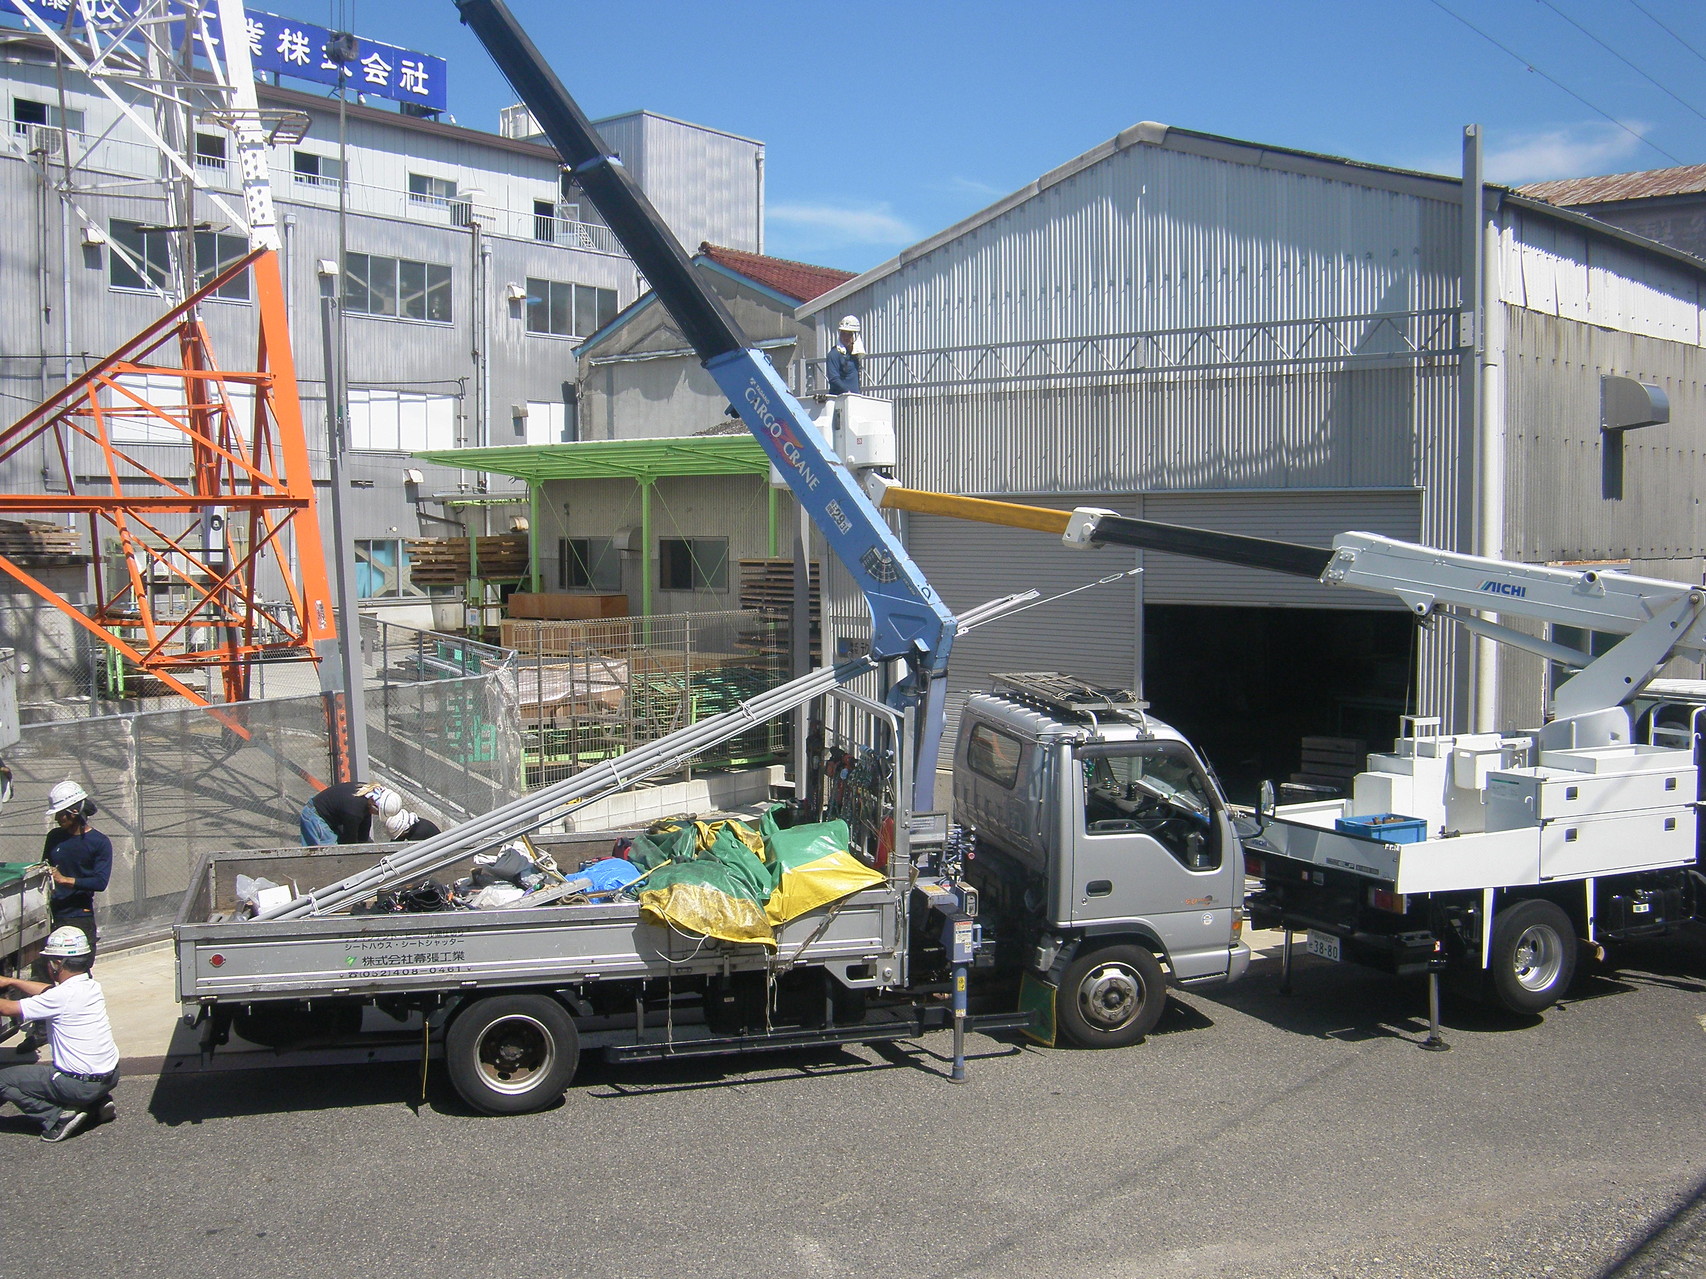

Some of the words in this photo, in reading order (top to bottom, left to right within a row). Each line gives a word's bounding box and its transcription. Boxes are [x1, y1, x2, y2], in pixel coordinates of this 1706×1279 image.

[745, 388, 782, 438] CARGO
[783, 442, 820, 491] CRANE
[1480, 580, 1526, 597] AICHI
[344, 938, 465, 951] シートハウス・シートシャッター
[1314, 941, 1338, 958] 38-80
